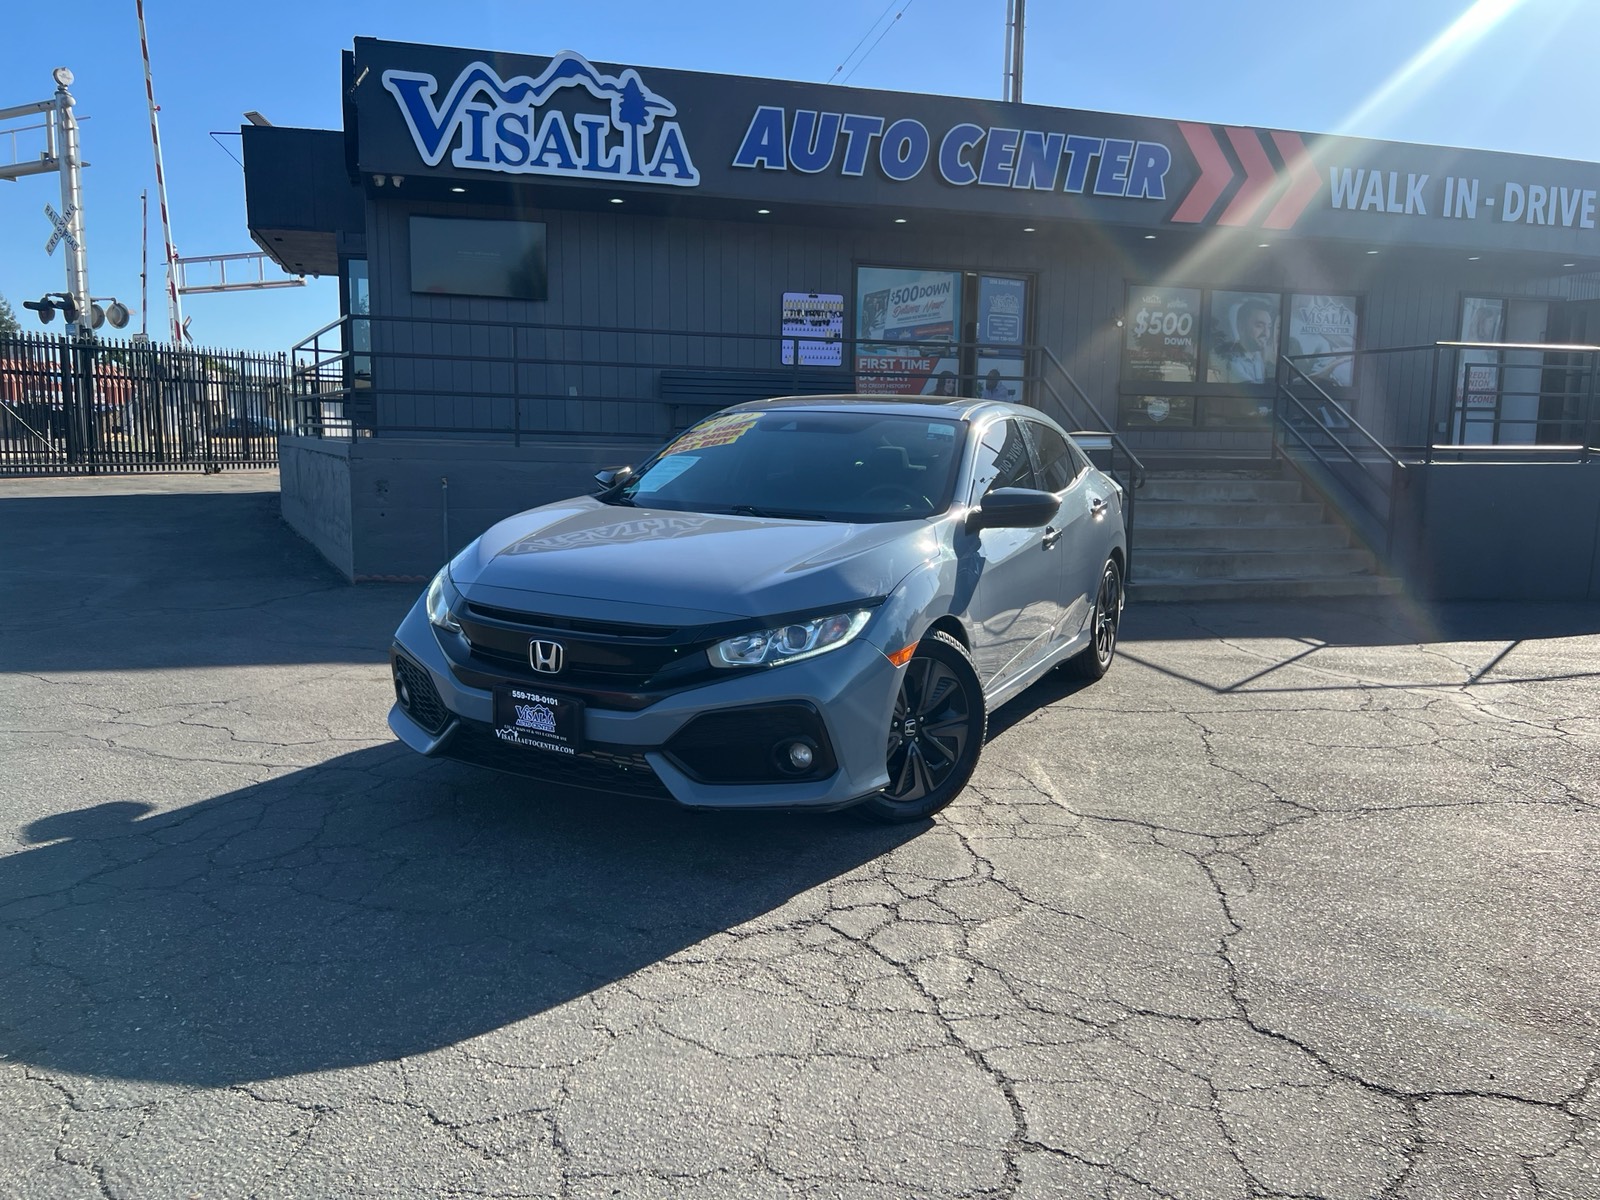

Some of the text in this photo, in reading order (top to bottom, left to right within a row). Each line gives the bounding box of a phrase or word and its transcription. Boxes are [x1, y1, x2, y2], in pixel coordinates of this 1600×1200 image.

[384, 52, 1171, 200] VISALIA AUTO CENTER
[1330, 166, 1430, 215] WALK
[1502, 182, 1597, 229] DRIVE
[46, 203, 77, 253] CROSSING
[890, 282, 951, 305] $500 DOWN
[1135, 307, 1193, 338] $500
[1321, 326, 1350, 334] CENTER
[1164, 337, 1192, 346] DOWN
[859, 358, 931, 370] FIRST TIME
[700, 437, 734, 447] BUY
[512, 690, 558, 706] 559-738-0101
[515, 704, 556, 726] VISALIA
[532, 722, 556, 733] CENTER
